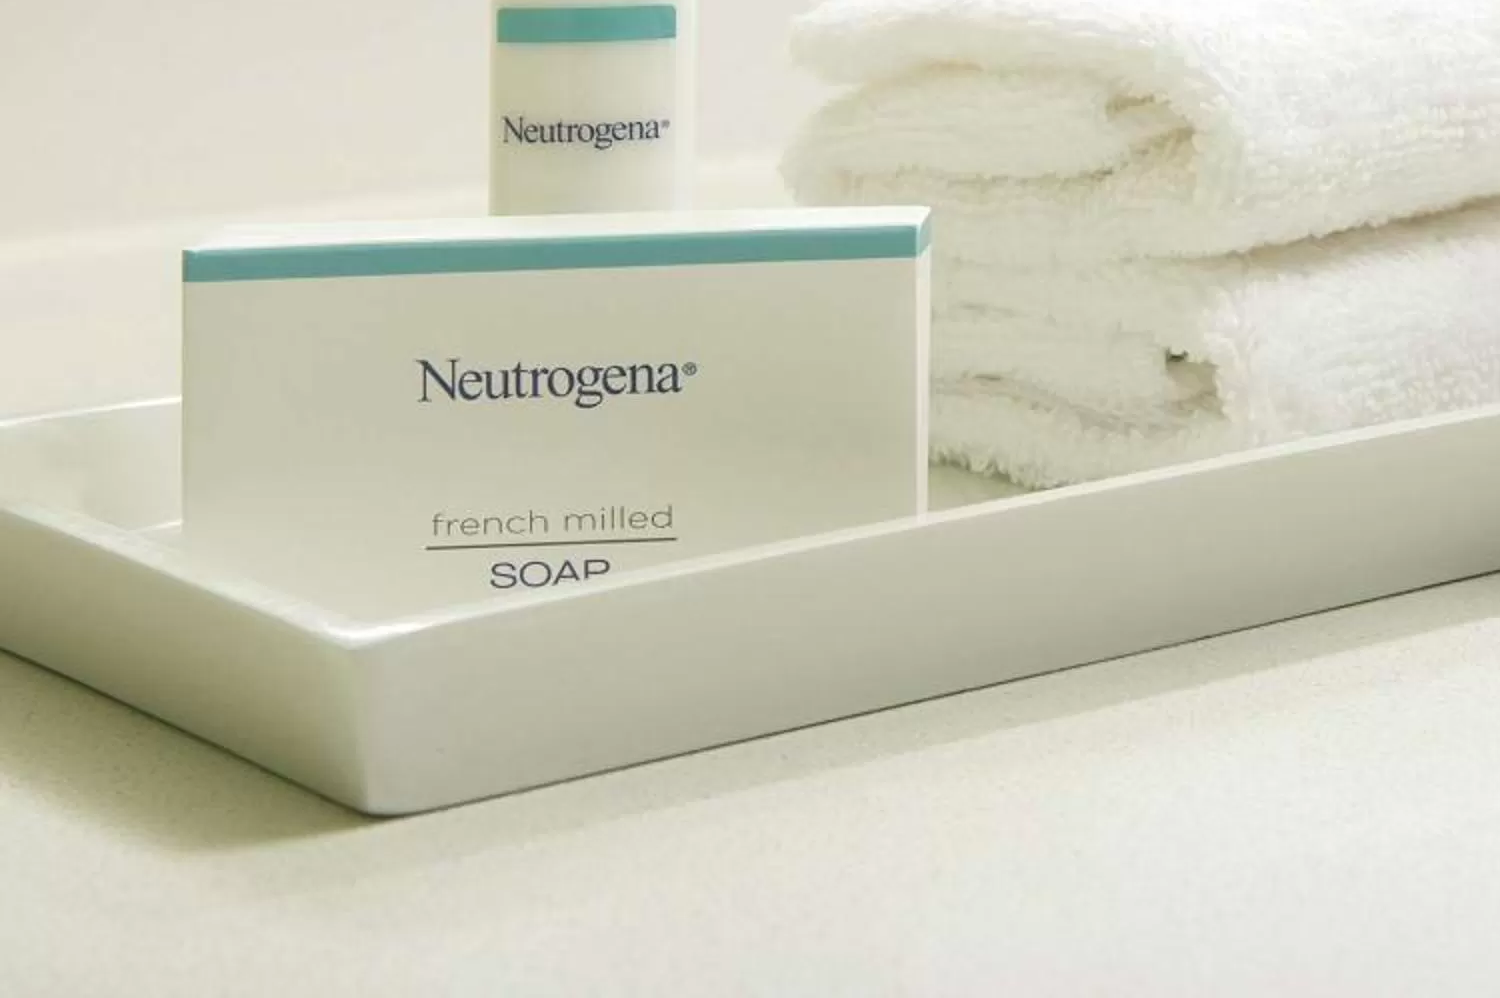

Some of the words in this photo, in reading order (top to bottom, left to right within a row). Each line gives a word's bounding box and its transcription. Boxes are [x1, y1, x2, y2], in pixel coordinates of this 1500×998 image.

[432, 509, 549, 536] french
[564, 504, 673, 532] milled
[490, 559, 611, 589] SOAP
